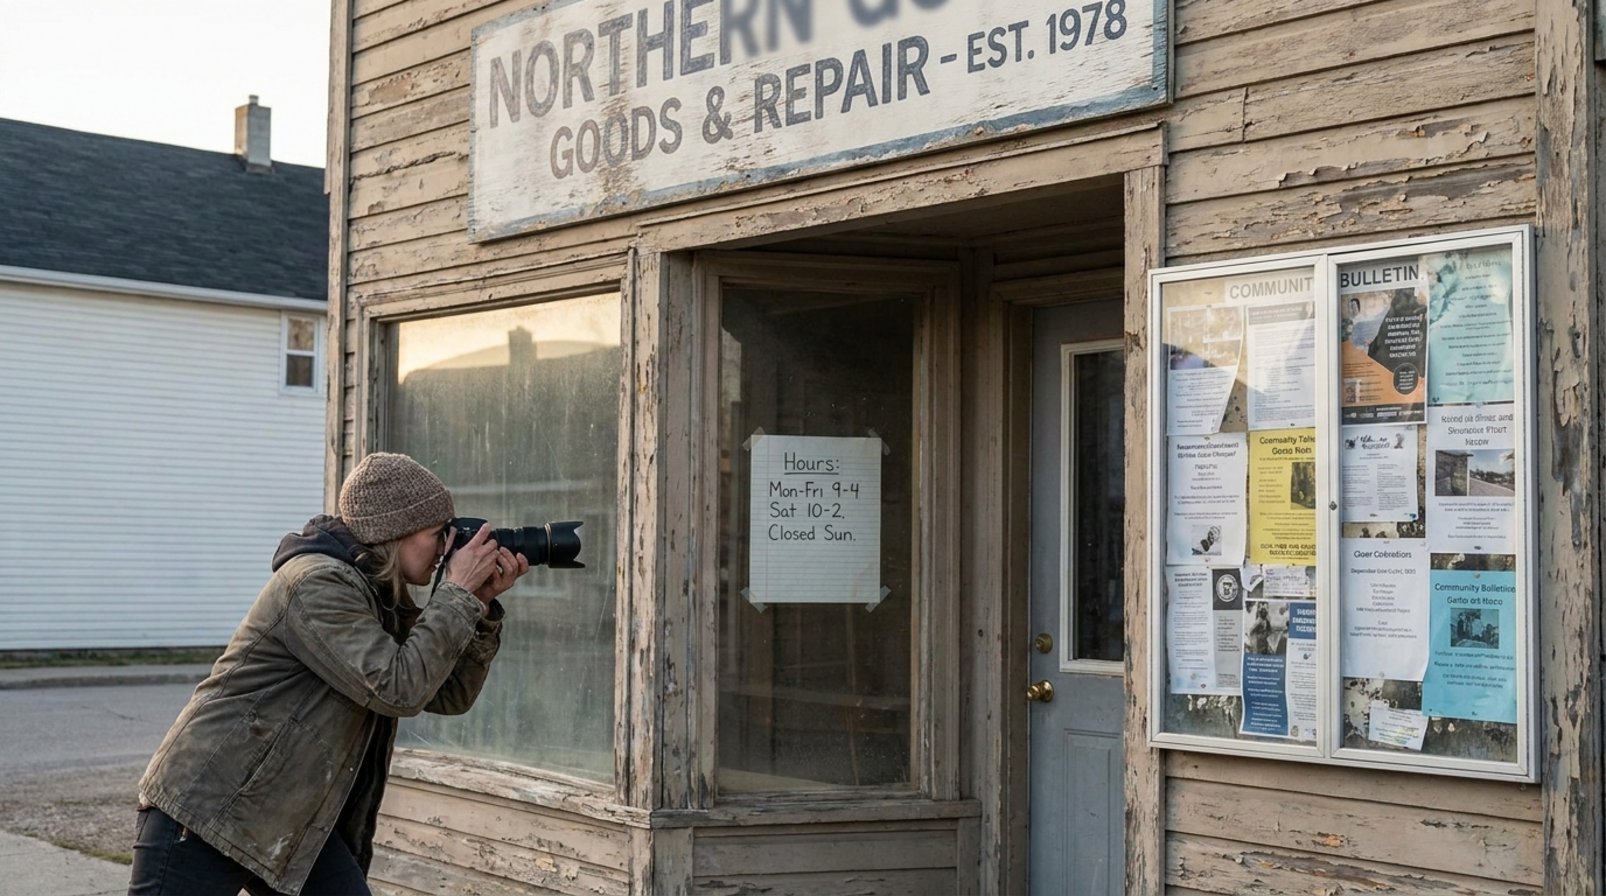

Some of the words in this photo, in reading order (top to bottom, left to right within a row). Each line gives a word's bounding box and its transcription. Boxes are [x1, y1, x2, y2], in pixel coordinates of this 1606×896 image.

[550, 97, 683, 180] GOODS
[702, 85, 734, 145] &
[754, 35, 931, 134] REPAIR
[967, 20, 1035, 74] EST.
[1045, 0, 1128, 55] 1978
[1340, 263, 1419, 289] BULLETIN
[784, 451, 840, 472] Hours:
[769, 481, 823, 498] Mon-Fri
[831, 481, 860, 499] 9-4
[769, 501, 797, 518] Sat
[768, 523, 816, 541] Closed
[823, 524, 857, 542] Sun.
[1434, 583, 1480, 594] Community
